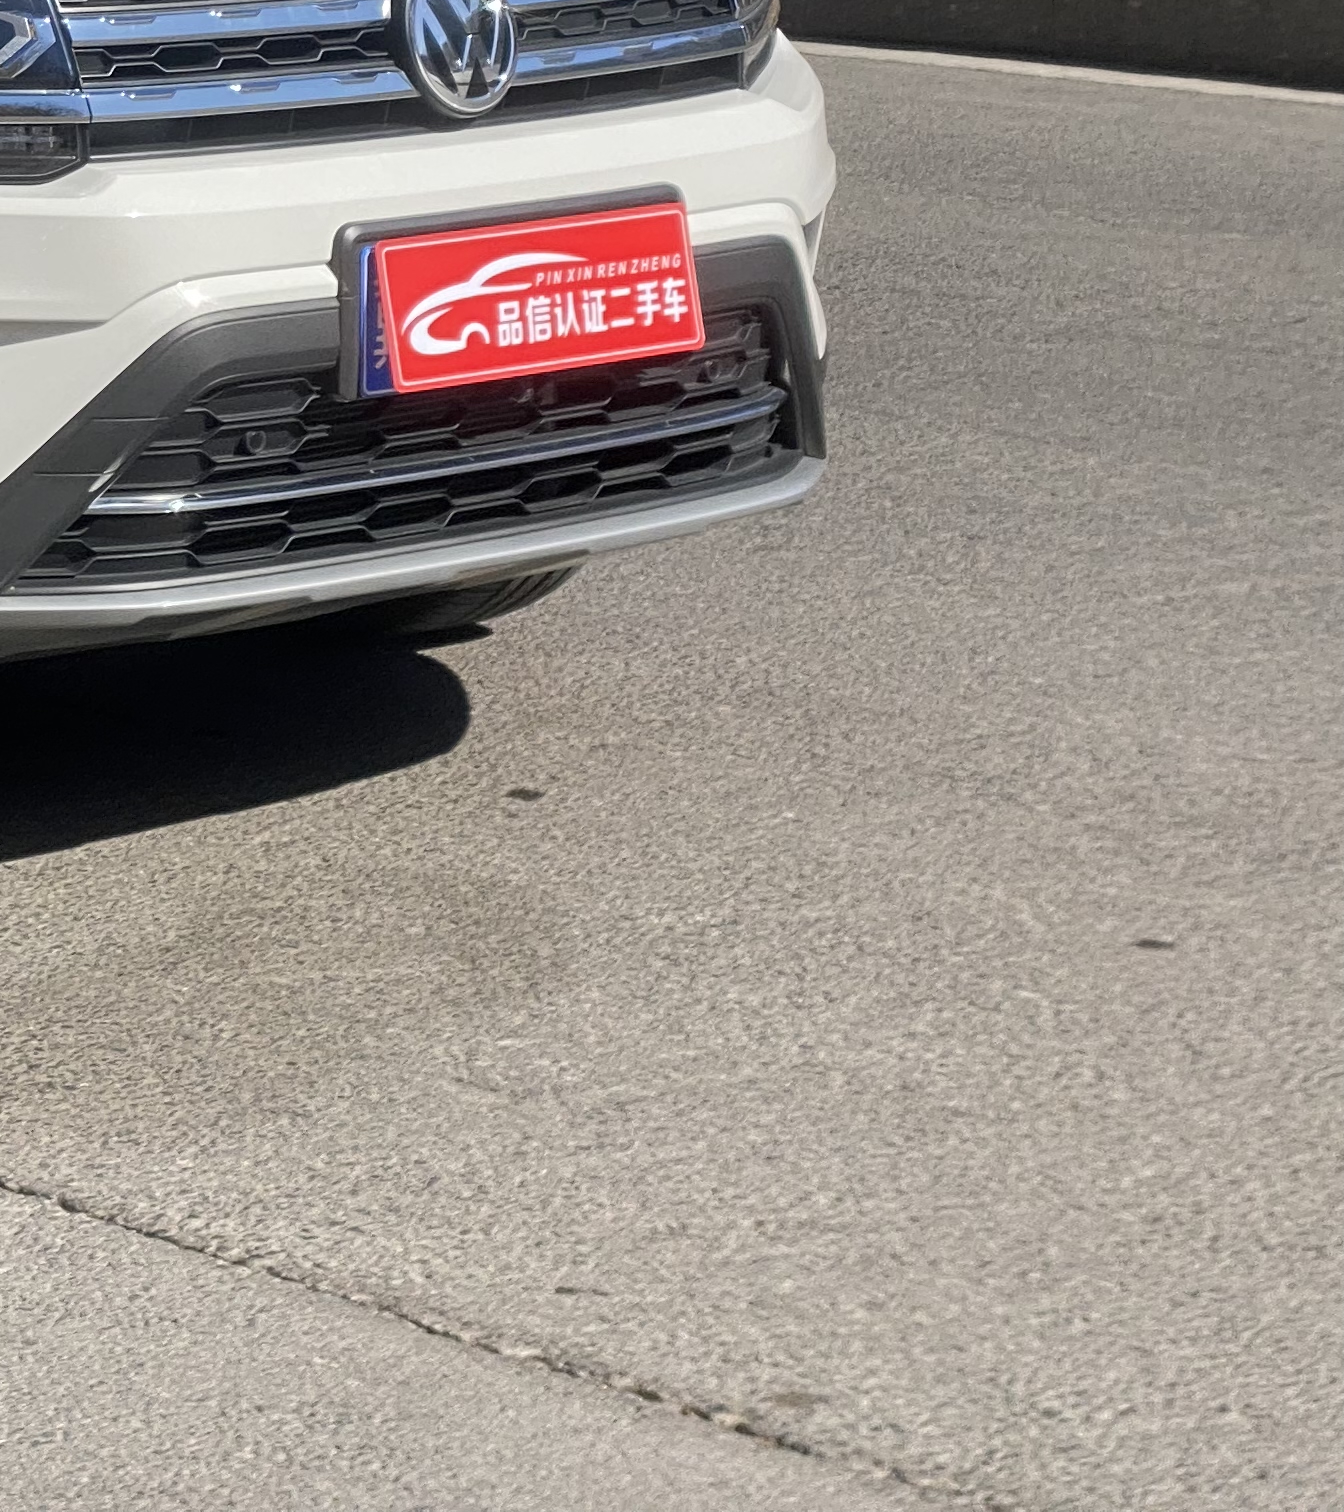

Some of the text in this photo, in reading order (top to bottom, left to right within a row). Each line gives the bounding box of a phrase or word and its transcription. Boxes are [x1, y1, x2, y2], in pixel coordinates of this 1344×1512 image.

[535, 253, 682, 287] PIN XIN REN ZHENG
[497, 277, 689, 347] 品信认证二手车
